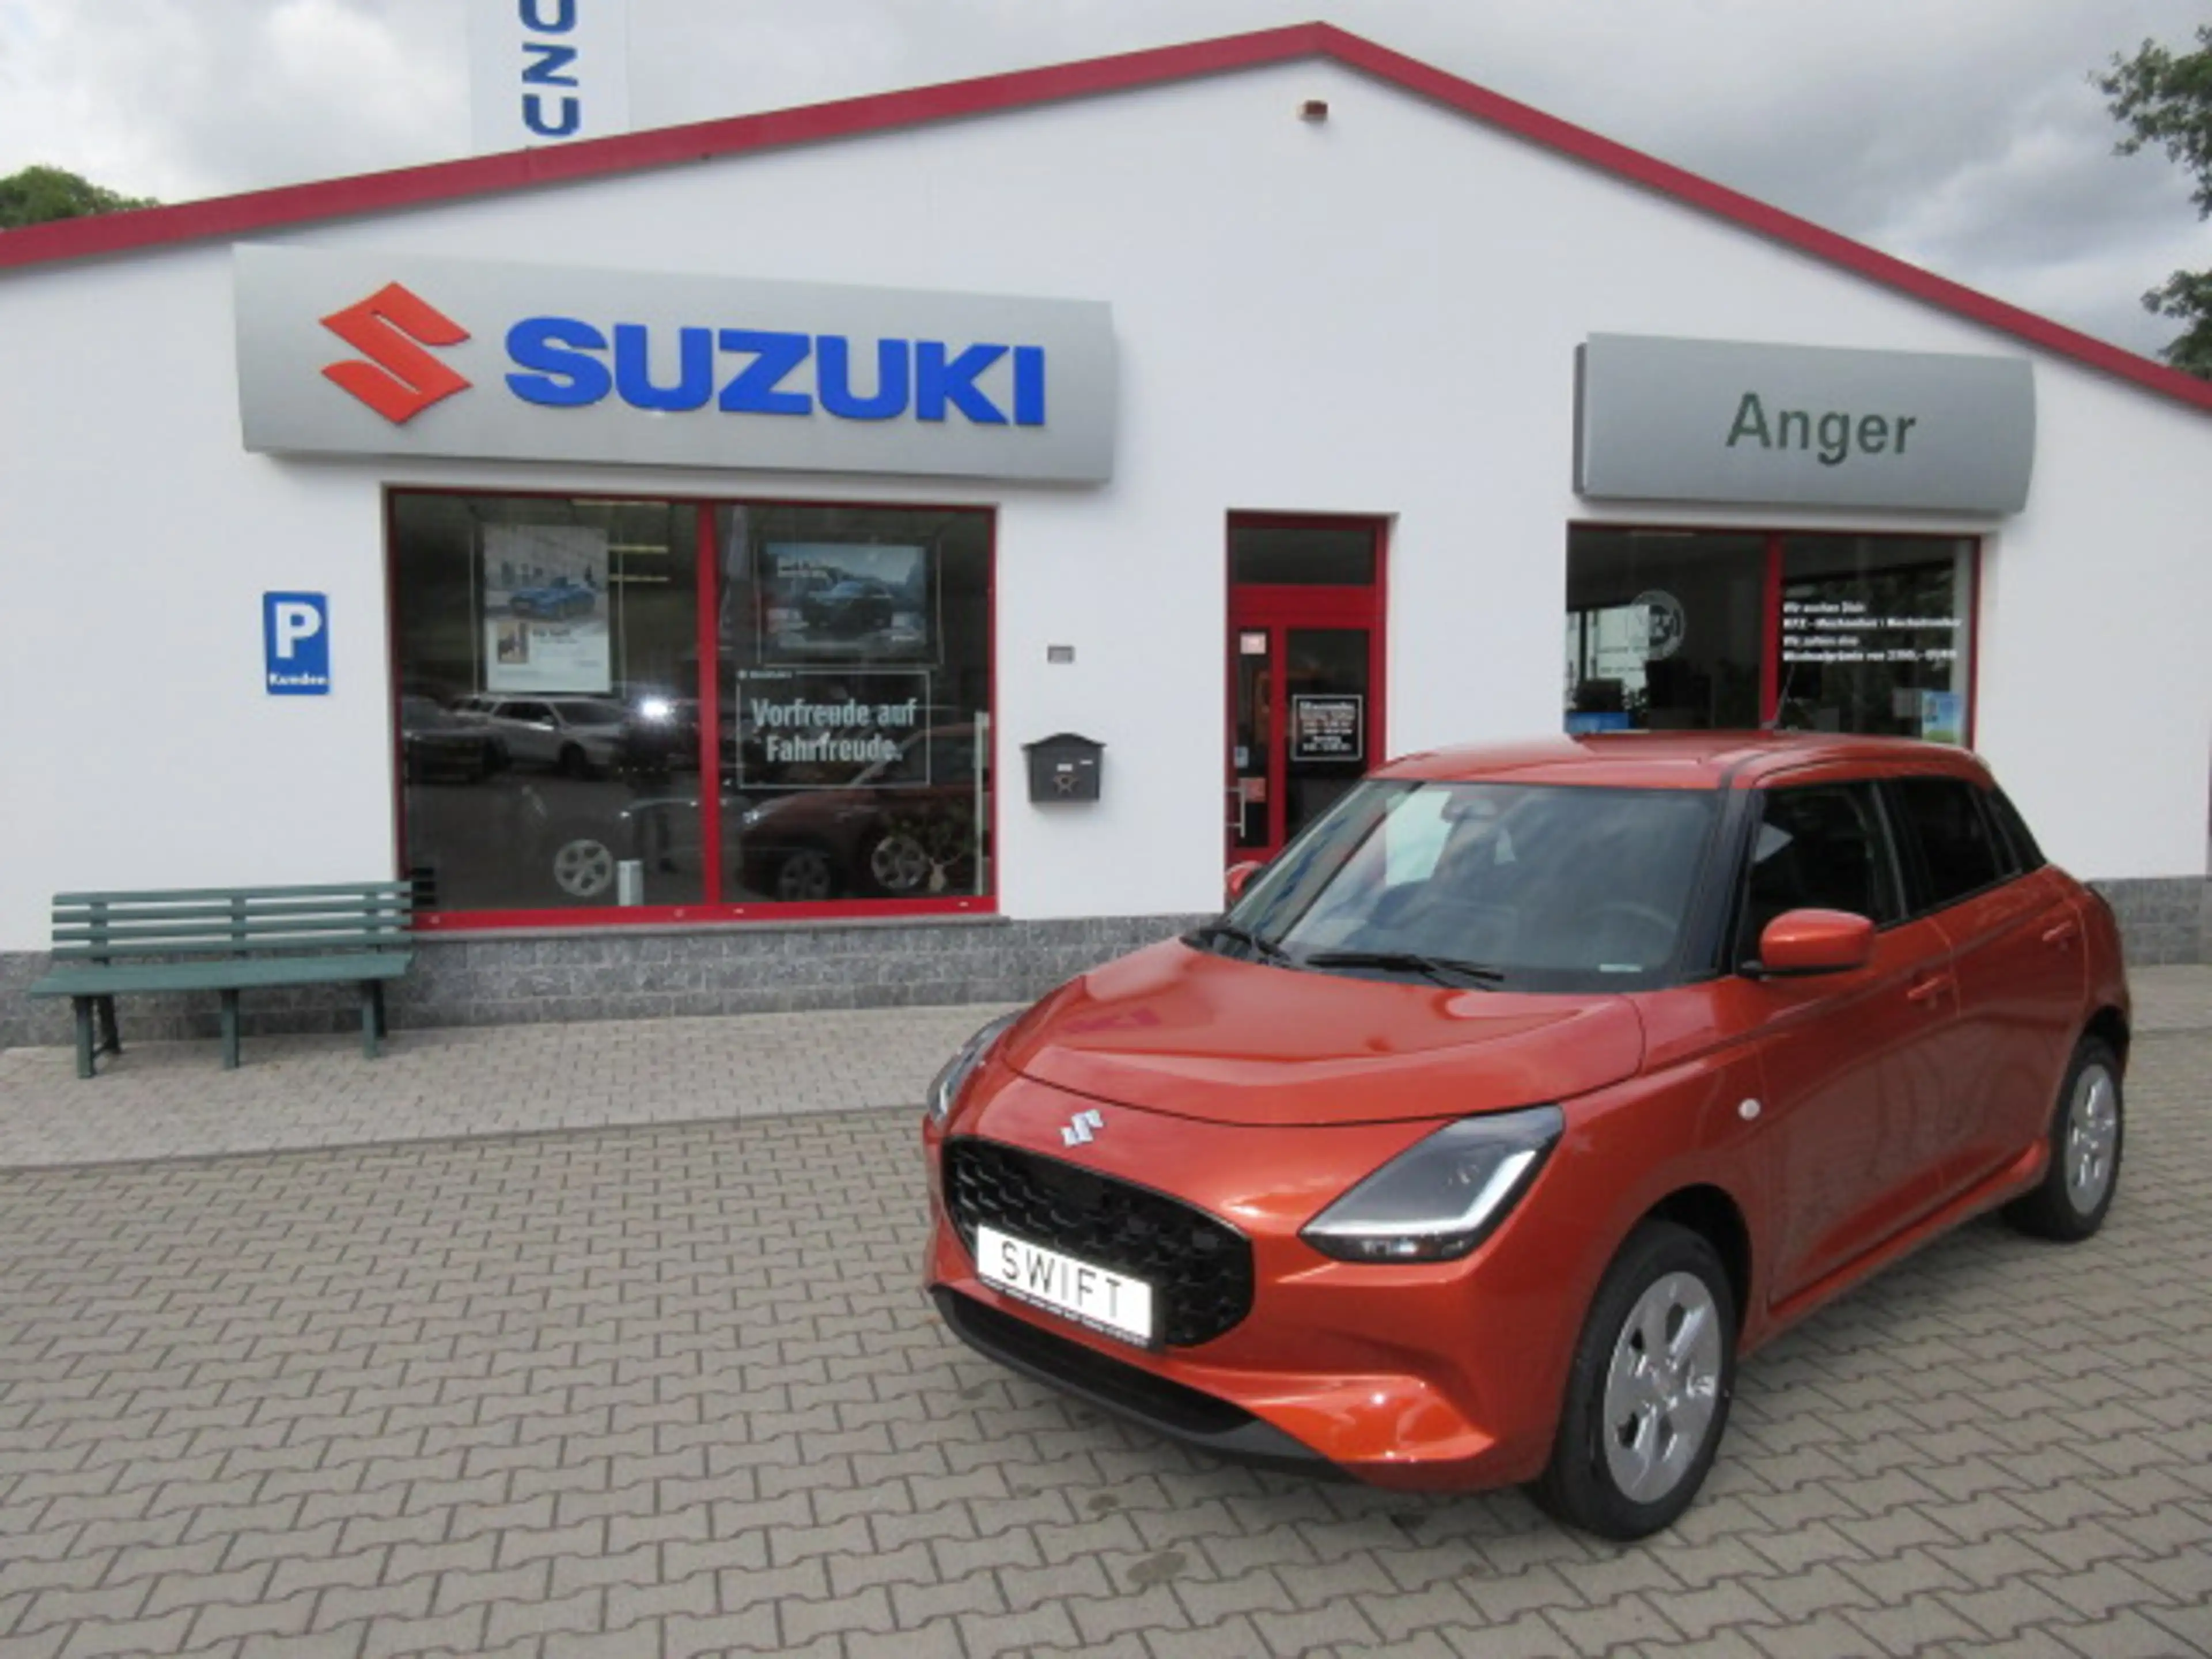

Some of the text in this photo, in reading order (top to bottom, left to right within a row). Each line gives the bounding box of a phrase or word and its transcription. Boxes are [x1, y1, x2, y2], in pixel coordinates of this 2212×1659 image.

[505, 316, 1046, 426] SUZUKI
[1726, 391, 1917, 466] Anger
[276, 602, 321, 658] P
[750, 698, 918, 727] Vorfreude auf
[766, 732, 903, 762] Fahrfreude.
[1001, 1240, 1123, 1319] SWIFT
